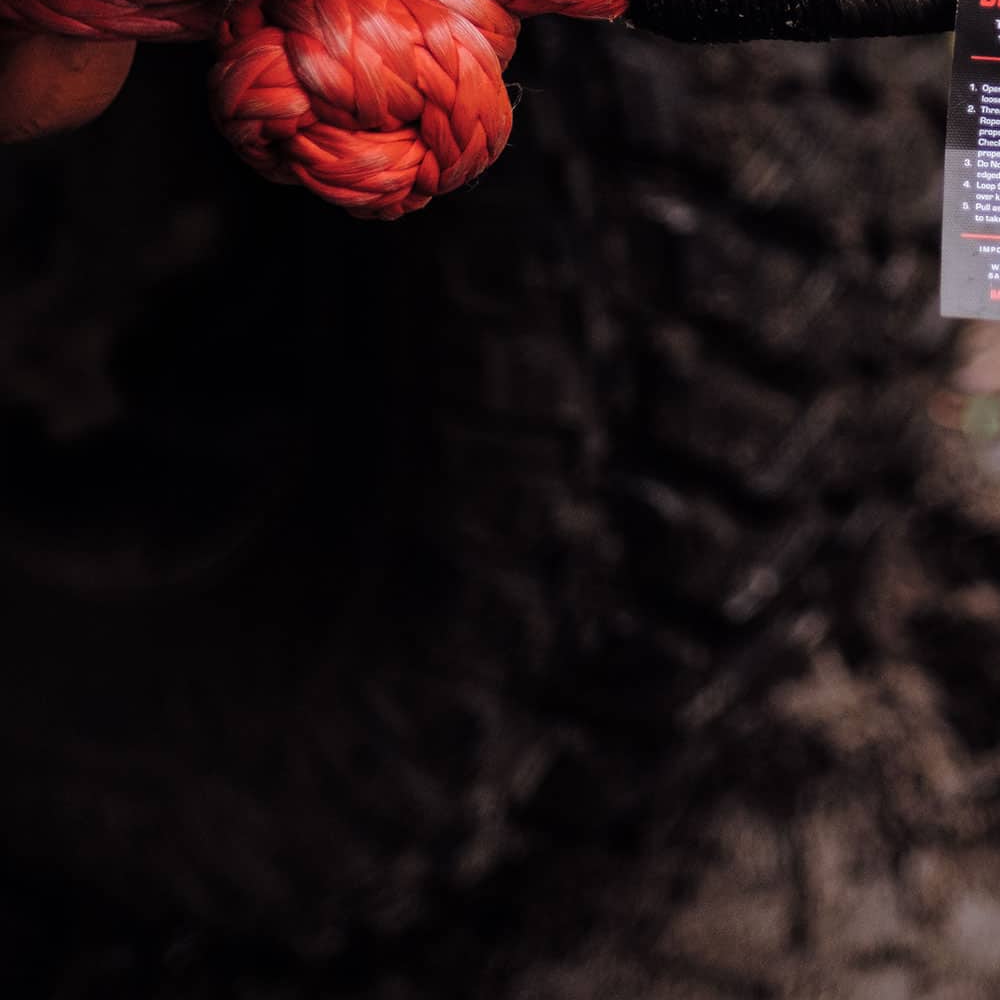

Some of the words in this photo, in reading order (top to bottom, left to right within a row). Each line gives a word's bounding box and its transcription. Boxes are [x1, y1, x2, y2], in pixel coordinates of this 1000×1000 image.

[969, 83, 977, 91] 1.
[980, 116, 1000, 126] Rope
[964, 158, 971, 166] 3.
[977, 159, 989, 167] Do
[977, 171, 1000, 180] edged
[976, 181, 996, 191] Loop
[975, 203, 990, 211] Pull
